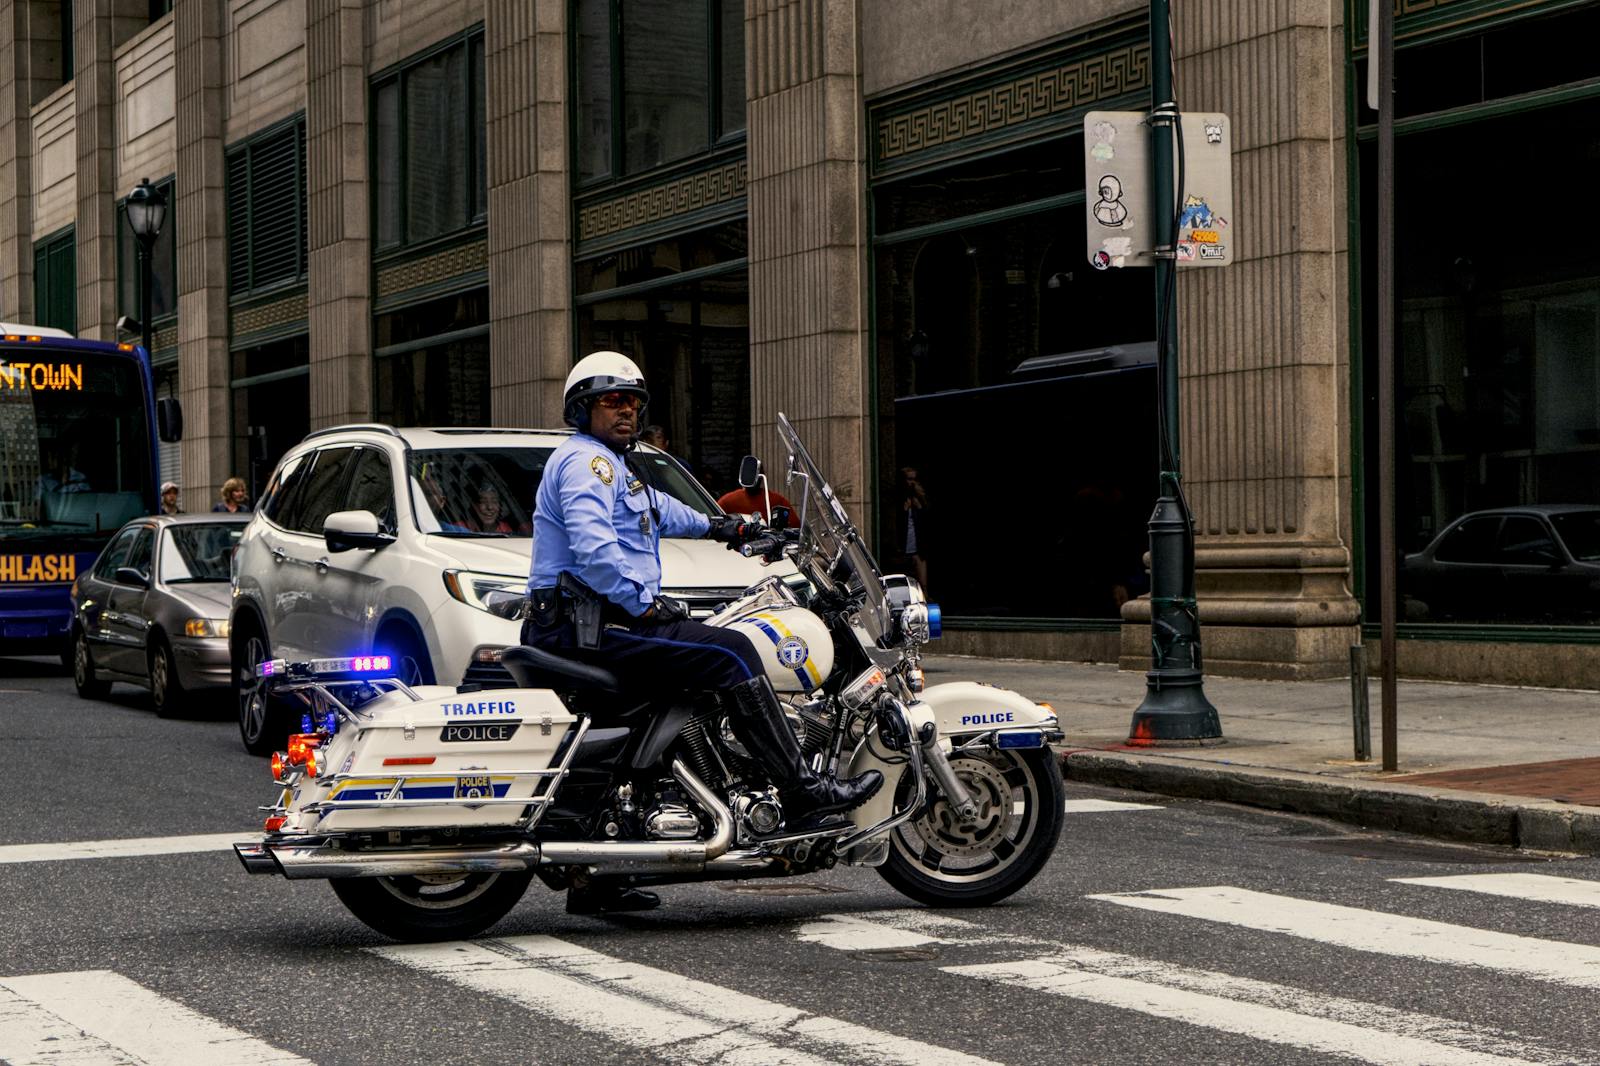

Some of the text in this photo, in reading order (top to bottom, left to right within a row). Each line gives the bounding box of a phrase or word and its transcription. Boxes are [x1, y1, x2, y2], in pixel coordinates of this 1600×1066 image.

[0, 363, 82, 390] NTOWN
[0, 554, 76, 581] HLASH
[440, 701, 515, 716] TRAFFIC
[962, 712, 1014, 725] POLICE
[447, 726, 508, 741] POLICE
[461, 777, 488, 787] POLICE
